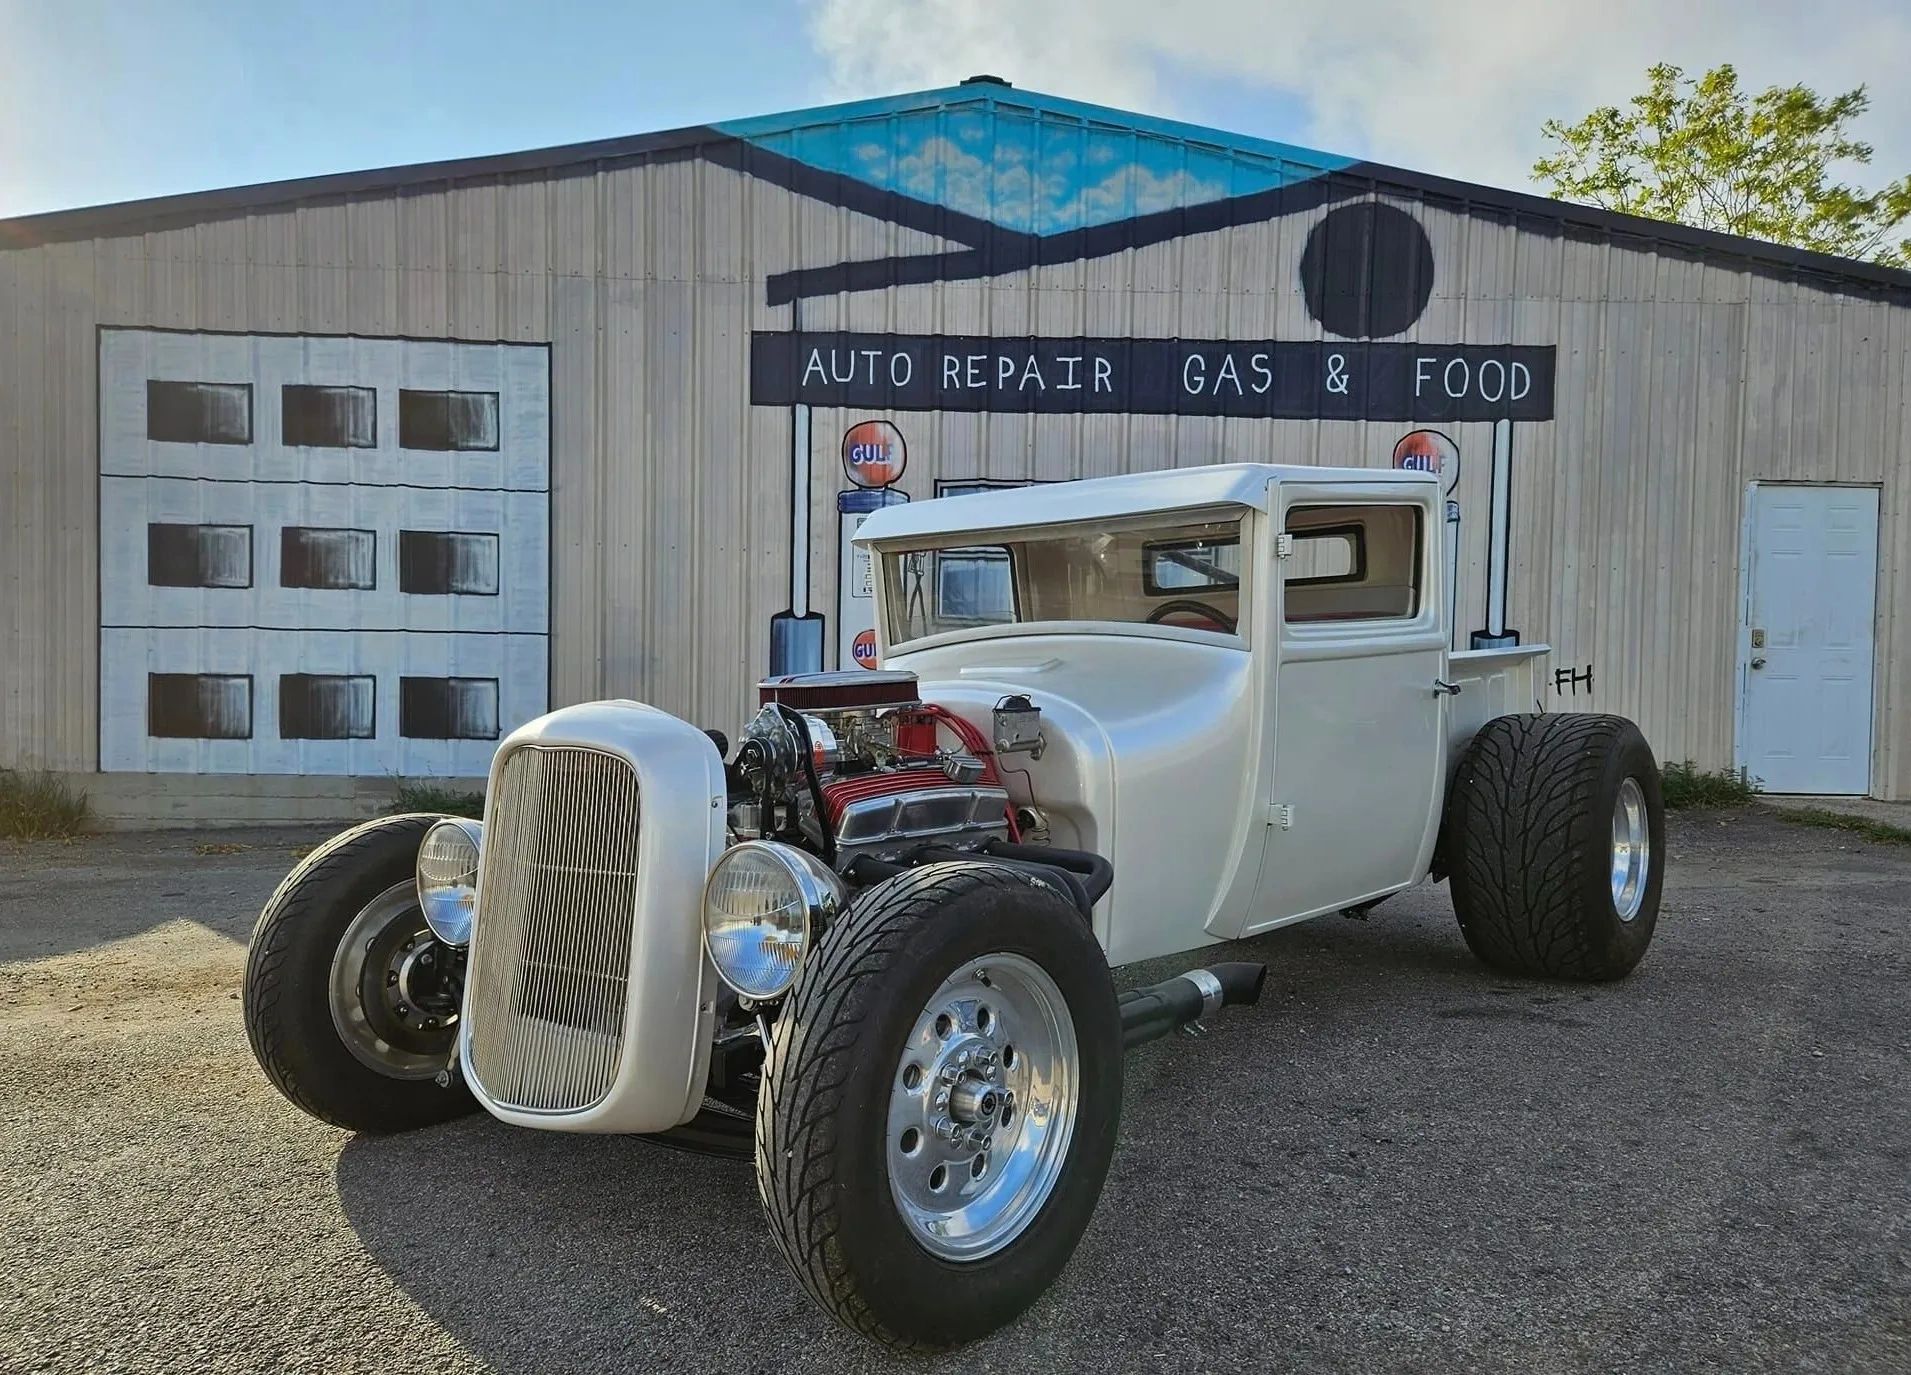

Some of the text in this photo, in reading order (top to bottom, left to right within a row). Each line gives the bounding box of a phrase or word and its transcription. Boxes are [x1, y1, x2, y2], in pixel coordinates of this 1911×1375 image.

[801, 347, 1531, 403] AUTO REPAIR GAS & FOOD
[850, 443, 894, 465] GULF
[1554, 664, 1593, 697] FH
